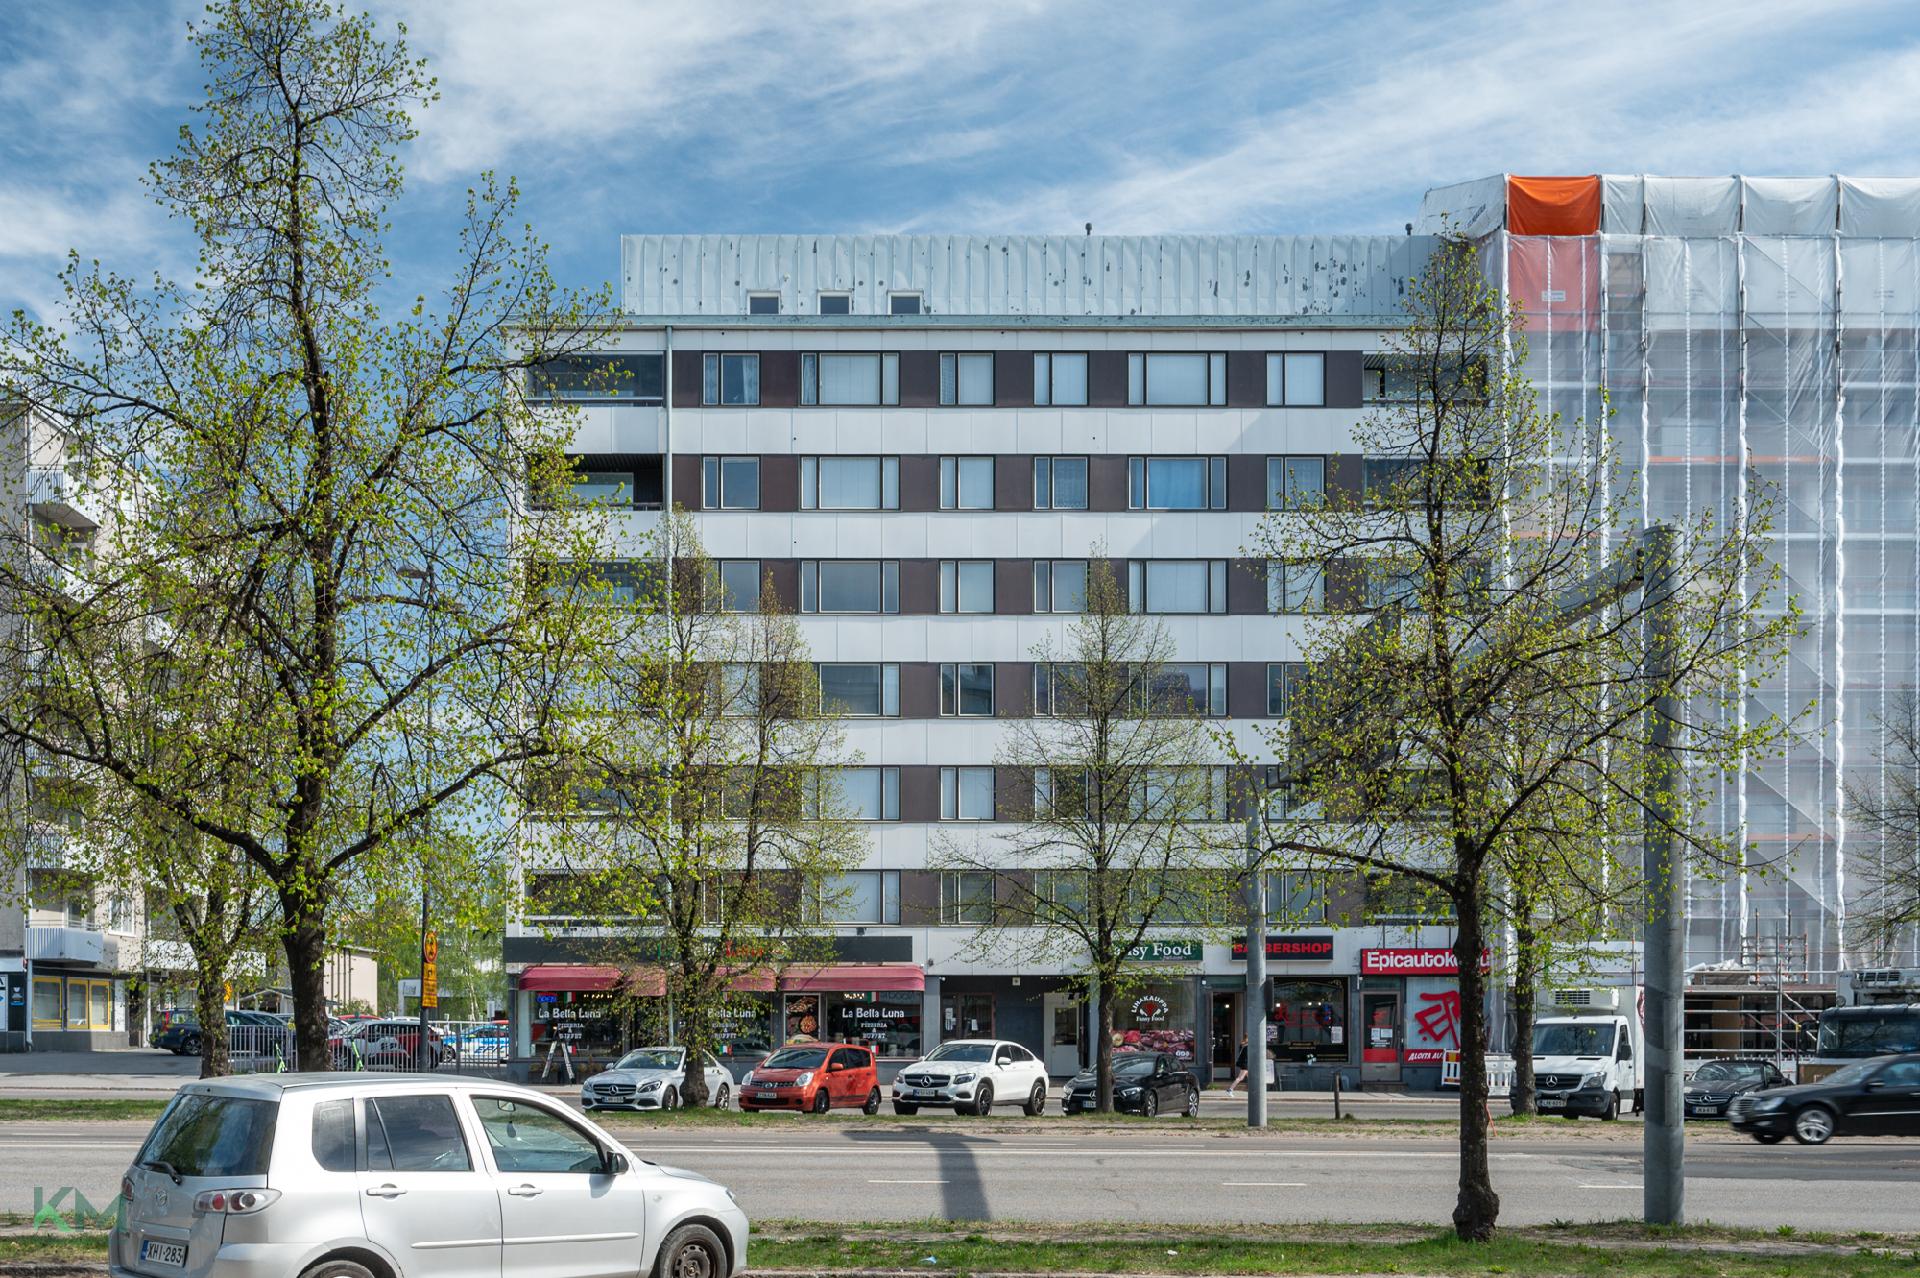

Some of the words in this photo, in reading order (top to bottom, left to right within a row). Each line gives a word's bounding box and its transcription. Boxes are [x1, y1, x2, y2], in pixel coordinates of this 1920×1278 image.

[1153, 942, 1192, 956] Food
[1233, 943, 1332, 953] BABERSHOP
[1131, 995, 1169, 1014] LIHAKAUPPA
[538, 1008, 549, 1018] La
[552, 1008, 576, 1019] Bella
[578, 1008, 601, 1019] Luna
[842, 1008, 853, 1018] La
[856, 1008, 879, 1018] Bella
[882, 1008, 904, 1018] Luna
[147, 1243, 184, 1264] XHI-283
